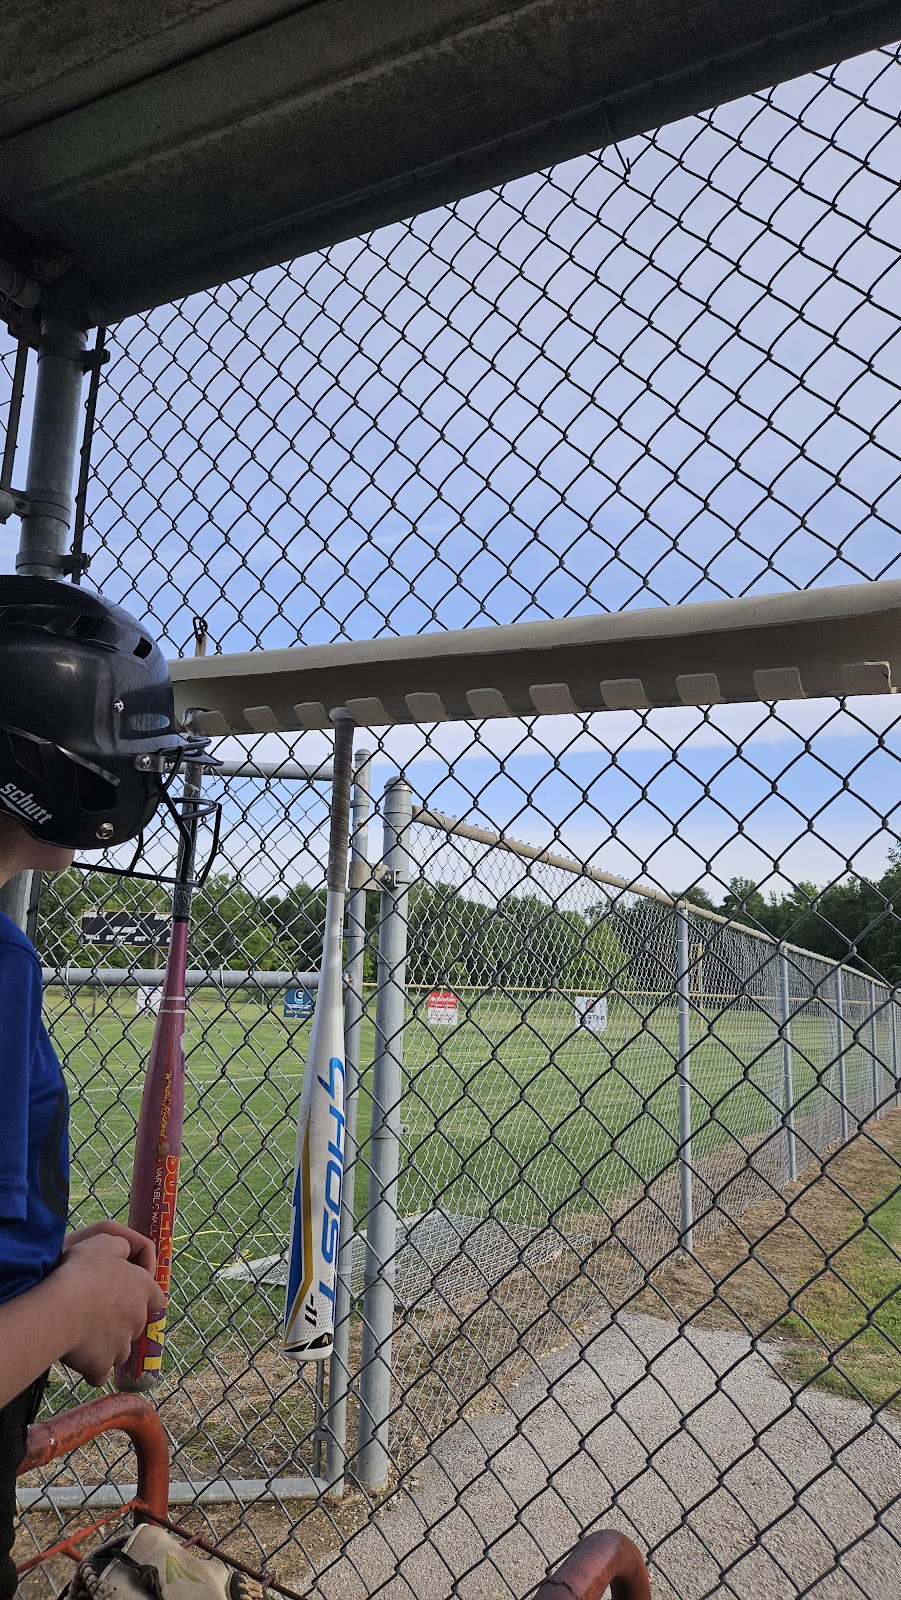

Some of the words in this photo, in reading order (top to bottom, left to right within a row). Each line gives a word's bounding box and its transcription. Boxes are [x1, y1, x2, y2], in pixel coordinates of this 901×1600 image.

[0, 782, 53, 825] schutt
[149, 1211, 159, 1236] WALL
[154, 1154, 181, 1315] SUPERCE
